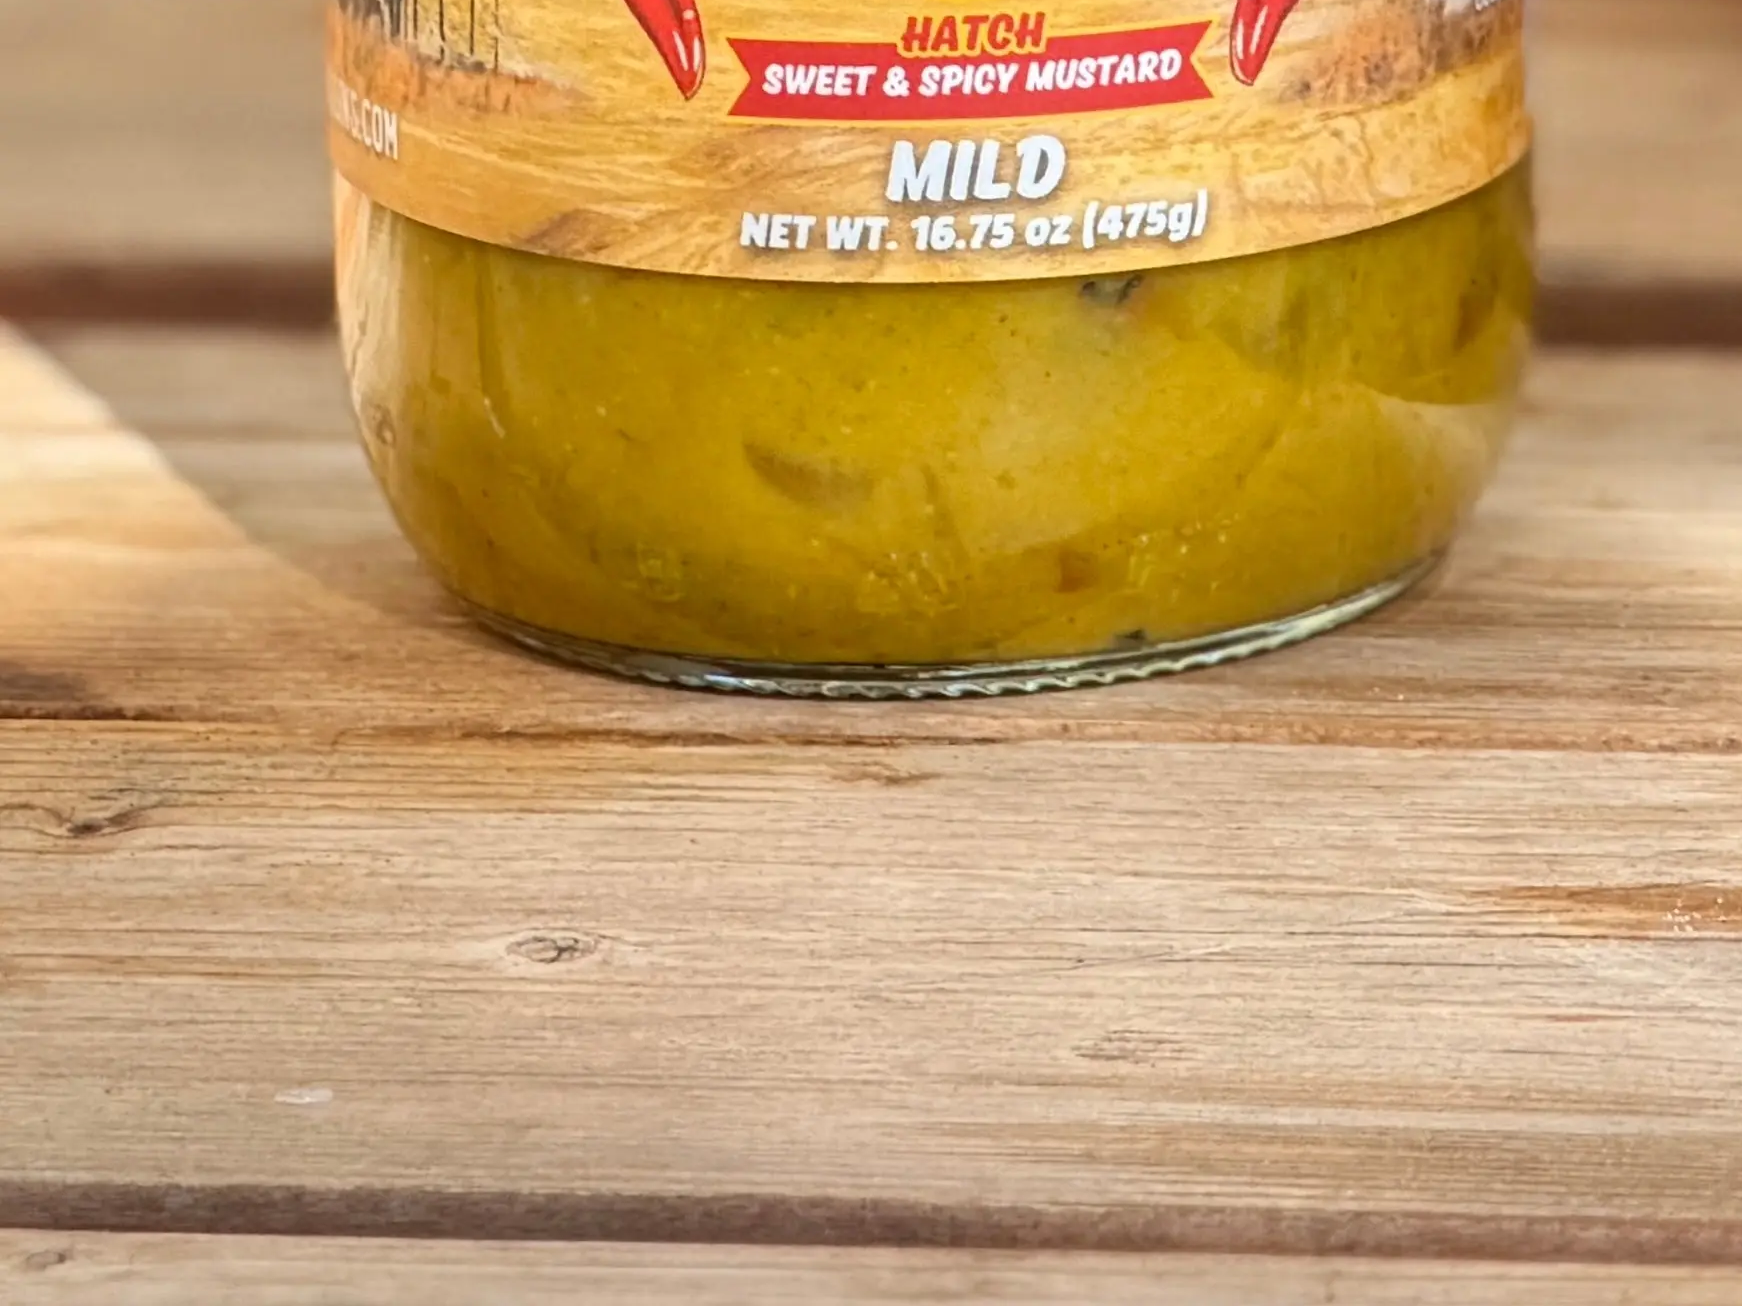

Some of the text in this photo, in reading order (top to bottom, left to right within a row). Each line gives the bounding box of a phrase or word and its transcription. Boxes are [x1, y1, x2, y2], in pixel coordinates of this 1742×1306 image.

[899, 10, 1047, 55] HATCH
[762, 47, 1183, 98] SWEET & SPICY MUSTARD
[884, 133, 1067, 203] MILD
[738, 188, 1208, 252] NET WT. 16.75 oz (475g)
